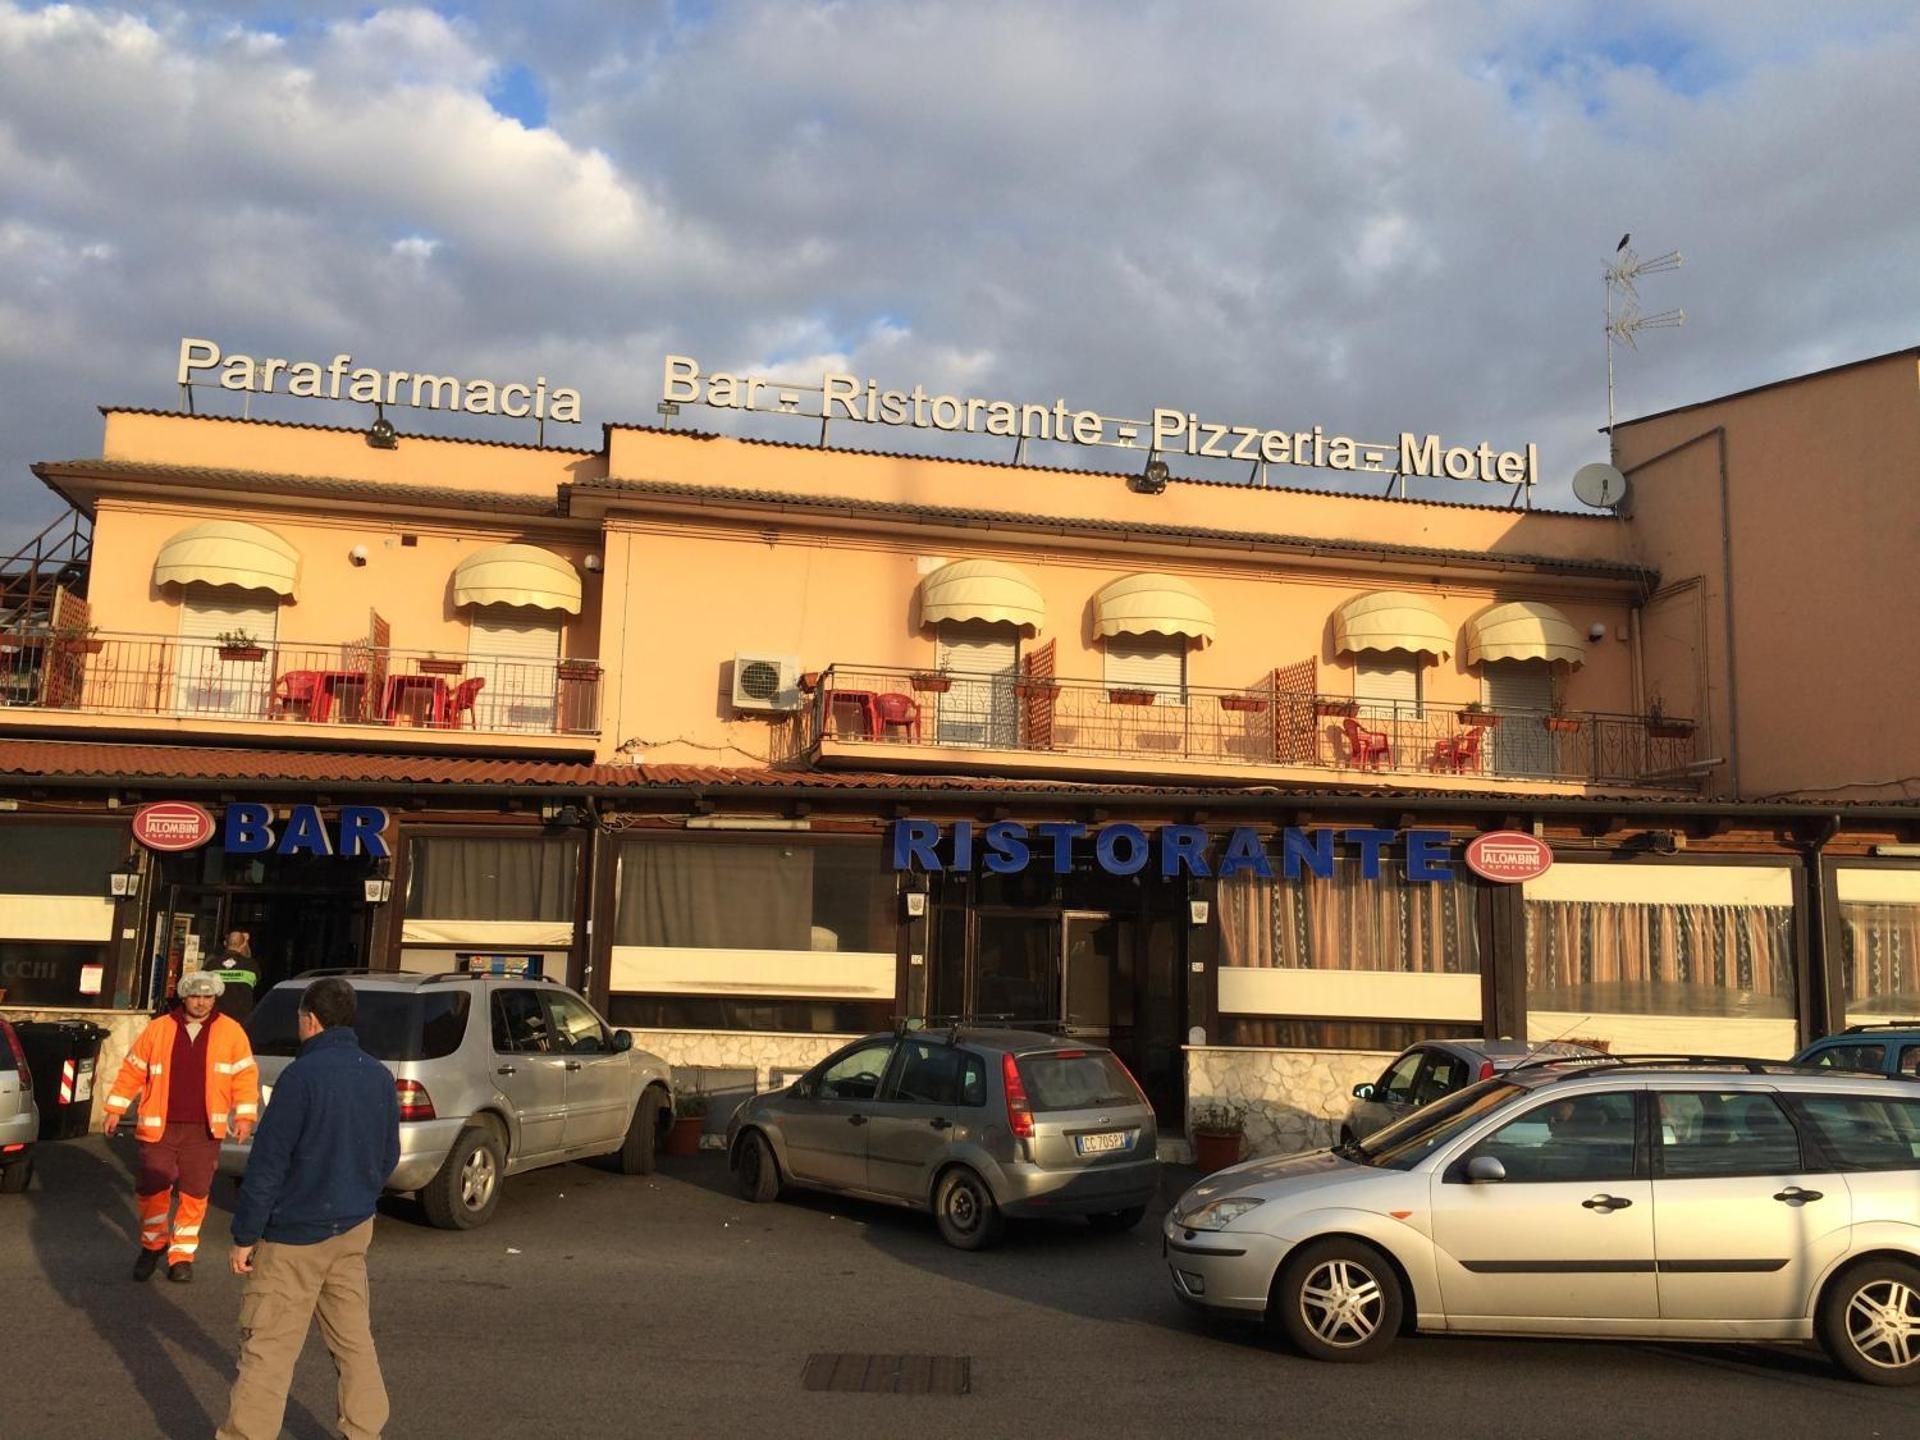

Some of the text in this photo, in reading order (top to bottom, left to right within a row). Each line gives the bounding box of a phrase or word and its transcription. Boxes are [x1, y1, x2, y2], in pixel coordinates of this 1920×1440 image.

[177, 338, 583, 424] Parafarmacia
[664, 355, 768, 411] Bar
[822, 373, 1103, 446] Ristorante
[1152, 408, 1356, 471] Pizzeria
[1399, 431, 1539, 486] Motel
[145, 814, 199, 834] PALOMBINI
[224, 803, 392, 856] BAR
[893, 820, 1455, 881] RISTORANTE
[1480, 843, 1540, 865] PALOMBINI
